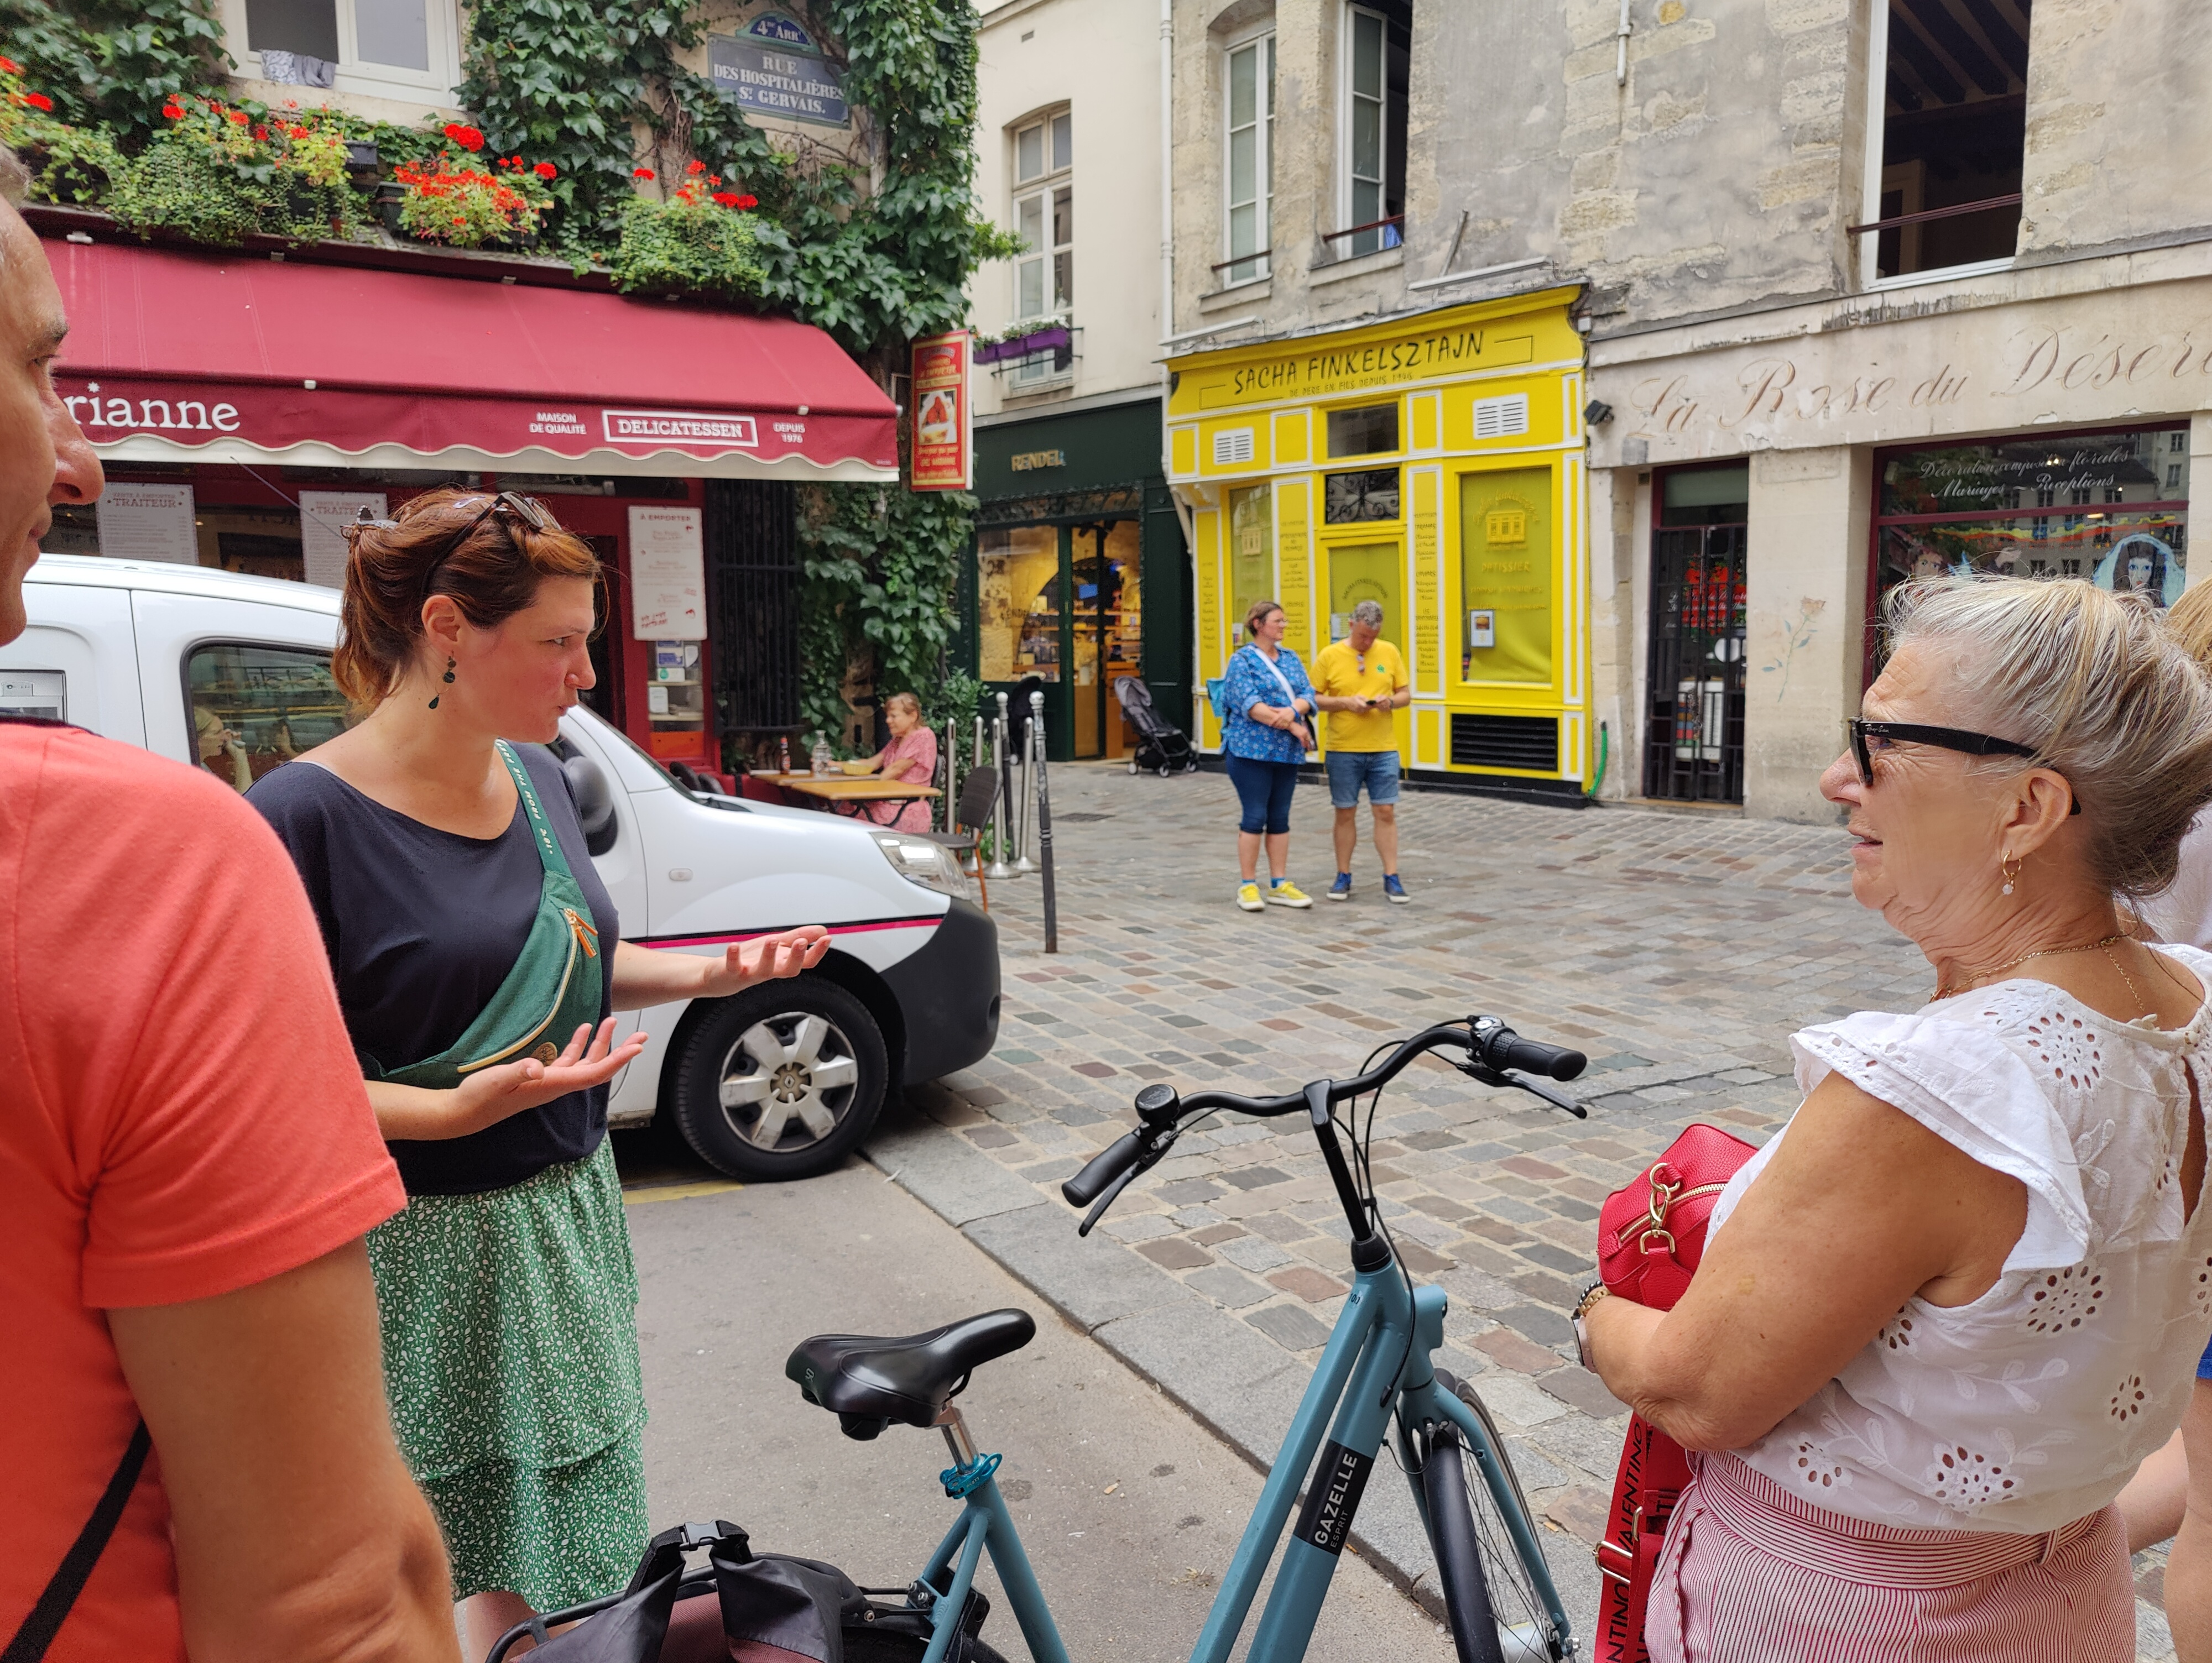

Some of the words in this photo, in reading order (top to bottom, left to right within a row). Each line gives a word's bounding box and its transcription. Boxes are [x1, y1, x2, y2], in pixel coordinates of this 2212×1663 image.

[763, 56, 797, 75] RUE
[714, 64, 739, 81] DES
[740, 69, 844, 100] HOSPITALIÈRES
[1234, 362, 1297, 395] SACHA
[1307, 330, 1484, 381] FINKELSZTAJN
[1359, 375, 1387, 389] DEPUIS
[1626, 375, 1699, 437] La
[1718, 357, 1895, 430] Rose
[1910, 363, 1972, 408] du
[1991, 324, 2212, 398] Déser
[62, 381, 241, 432] rianne
[536, 412, 577, 423] MAISON
[529, 423, 545, 433] DE
[617, 419, 744, 438] DELICATESSEN
[773, 422, 806, 434] DEPUIS
[2069, 445, 2130, 474] florales
[1931, 478, 2006, 503] Mariages
[113, 498, 176, 508] TRAITEUR
[316, 507, 358, 515] TRAITE
[512, 766, 527, 786] THE
[524, 790, 542, 820] FROM
[1348, 1293, 1360, 1305] 100
[1314, 1453, 1358, 1545] GAZELLE
[1330, 1509, 1349, 1548] ESPRIT
[1606, 1582, 1630, 1663] NTINO
